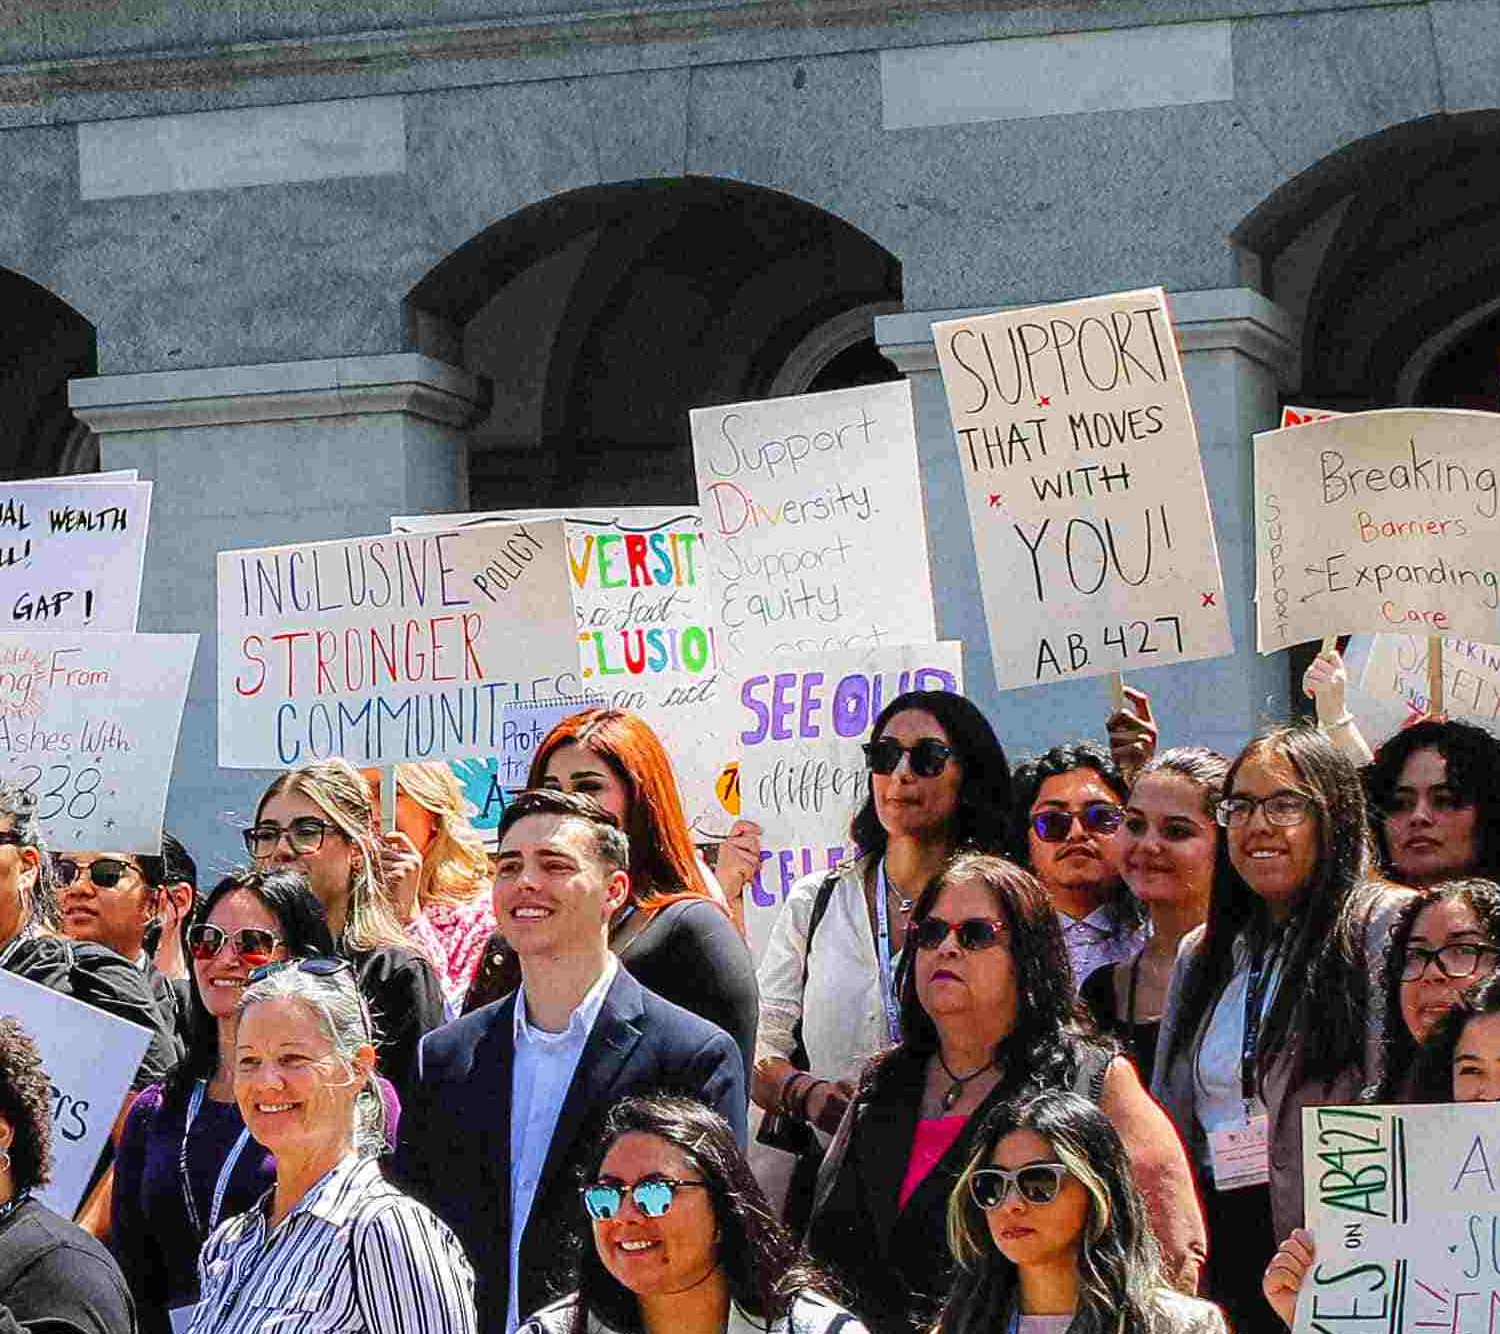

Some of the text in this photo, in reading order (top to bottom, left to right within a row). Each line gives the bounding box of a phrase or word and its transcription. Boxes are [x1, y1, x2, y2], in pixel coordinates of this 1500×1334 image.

[951, 308, 1167, 414] SUPPORT
[709, 411, 878, 479] Support
[957, 405, 1163, 472] THAT MOVES
[1032, 462, 1130, 501] WITH
[1320, 436, 1497, 518] Breaking
[50, 507, 127, 532] WEALTH
[1358, 511, 1467, 543] Barriers
[241, 524, 546, 617] INCLUSIVE POLICY
[717, 536, 853, 581] Support
[1014, 505, 1175, 602] YOU!
[1265, 494, 1289, 644] SUPPORT
[1326, 553, 1499, 609] Expanding
[1104, 617, 1183, 658] 427
[1383, 602, 1449, 629] Care
[50, 648, 110, 688] From
[236, 613, 485, 698] STRONGER
[740, 671, 824, 746] SEE
[1318, 1108, 1388, 1218] AB427
[1345, 1222, 1362, 1249] ON
